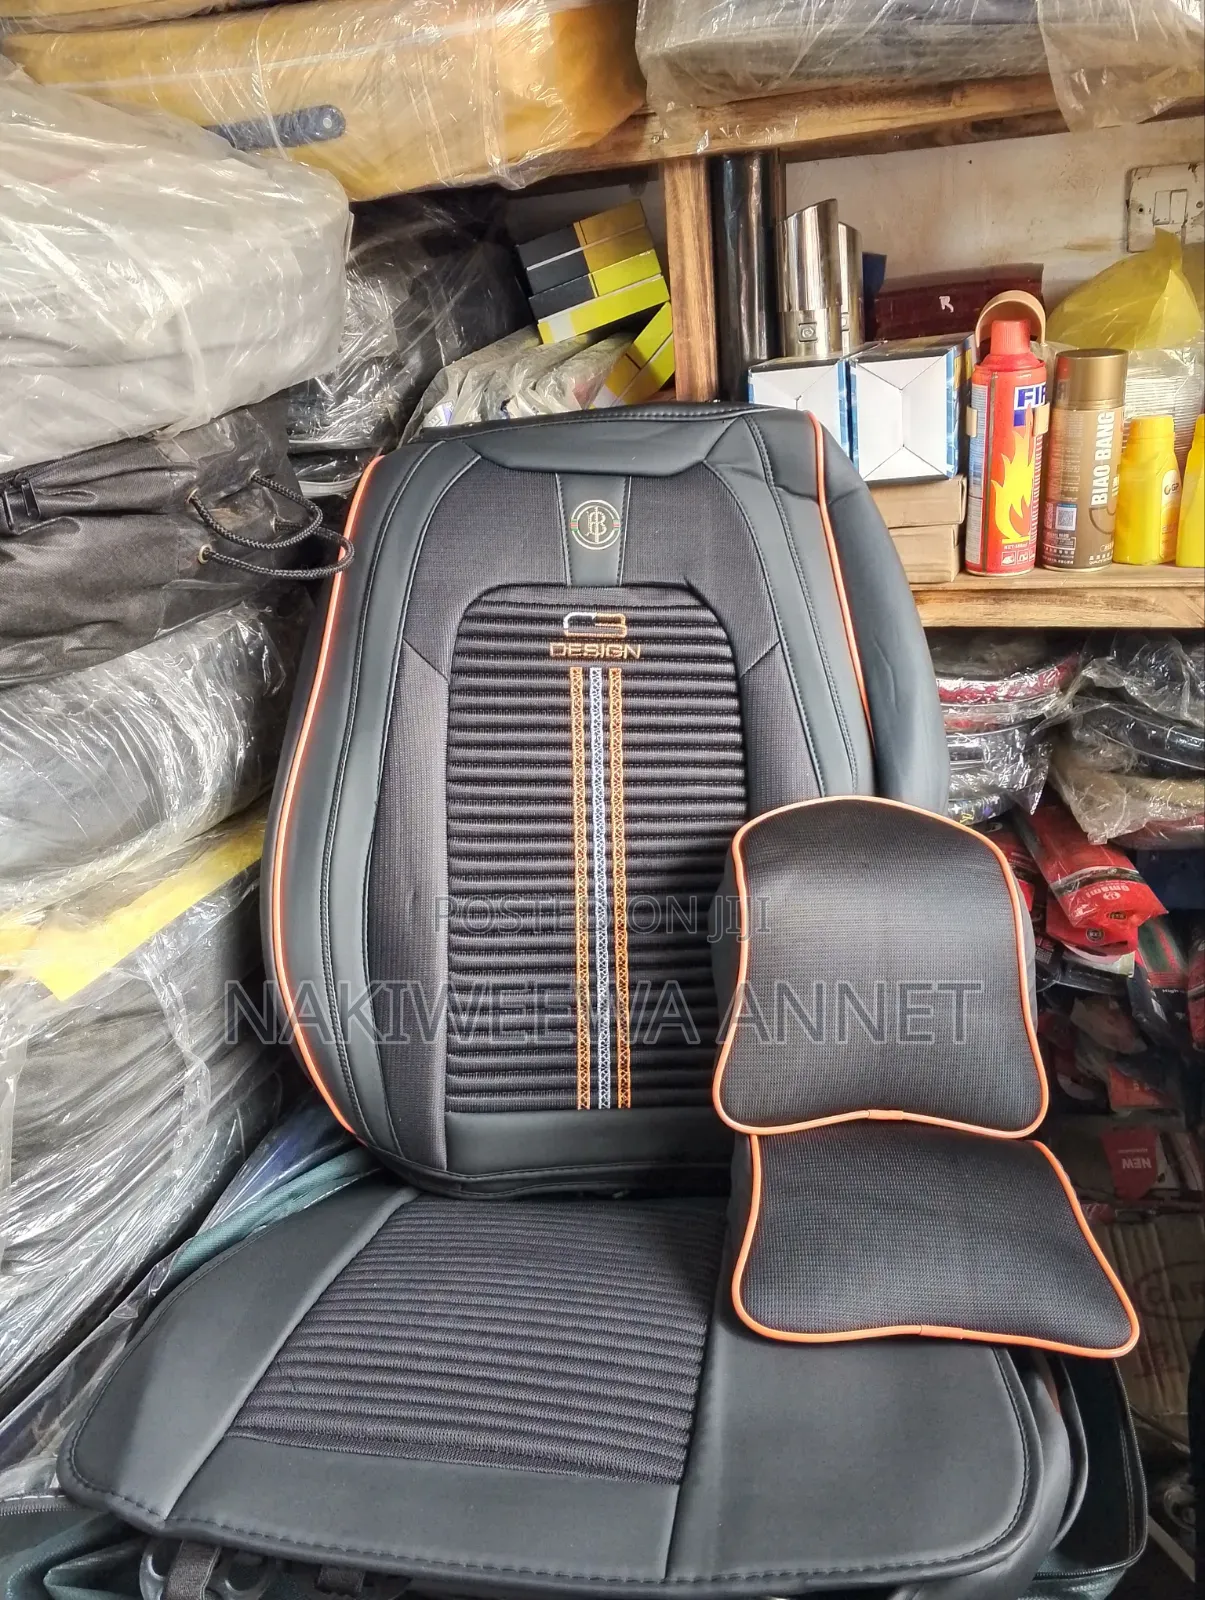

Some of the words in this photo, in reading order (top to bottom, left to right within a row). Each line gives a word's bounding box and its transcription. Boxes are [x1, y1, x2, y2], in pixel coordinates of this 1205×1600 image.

[1095, 411, 1115, 460] BANG
[1091, 464, 1111, 506] BIAO
[550, 642, 641, 659] DESIGN
[1121, 1158, 1152, 1170] NEW
